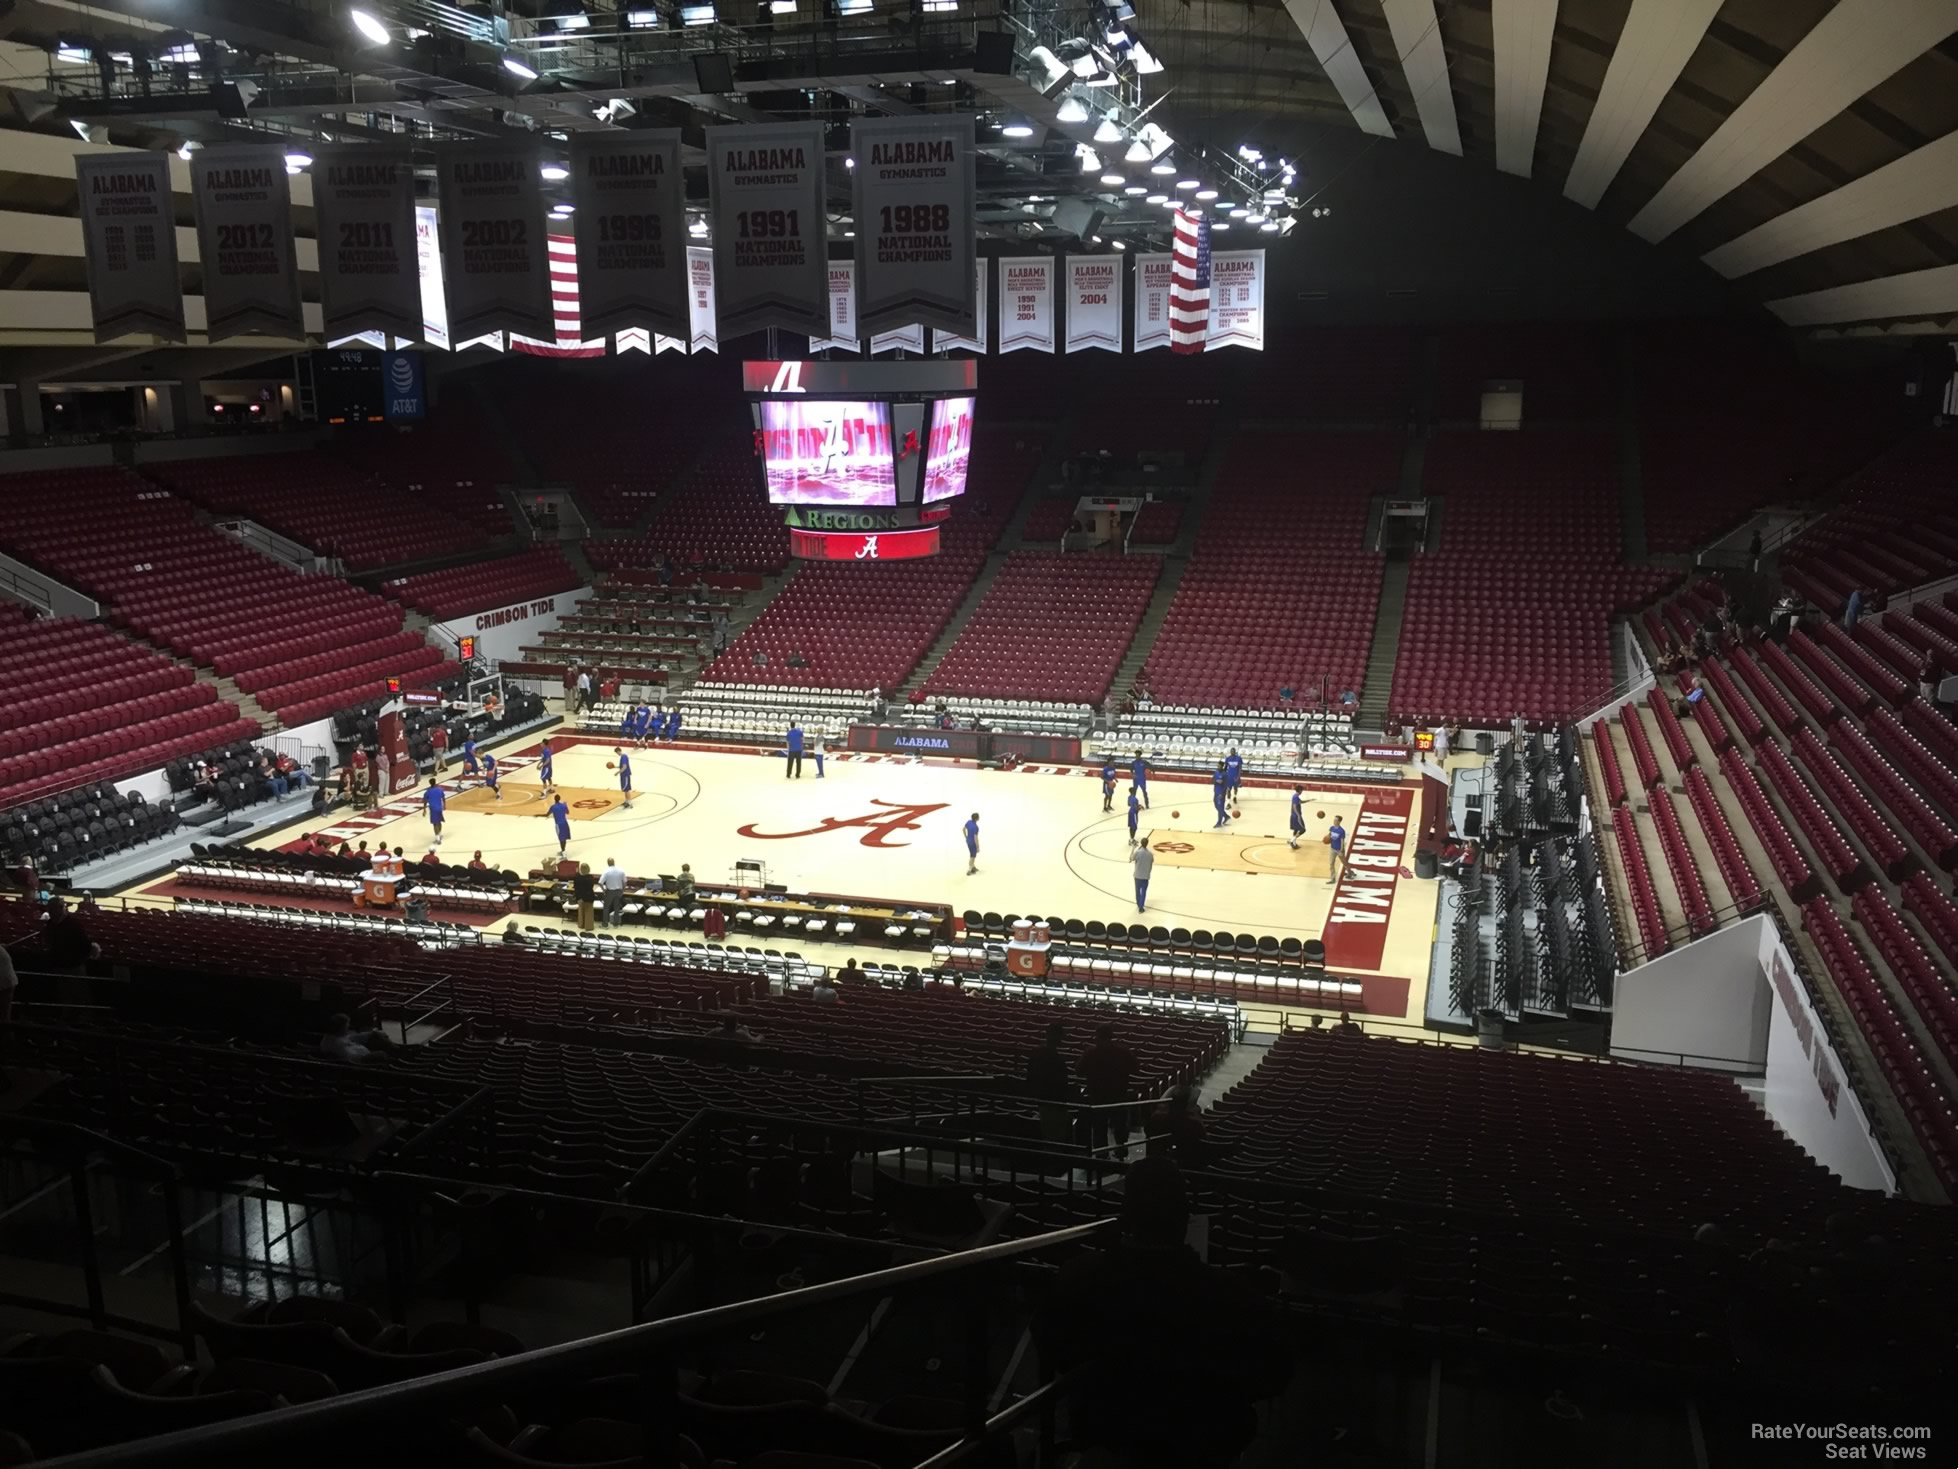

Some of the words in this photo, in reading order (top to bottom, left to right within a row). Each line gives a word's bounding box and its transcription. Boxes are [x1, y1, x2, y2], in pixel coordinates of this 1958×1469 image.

[726, 147, 805, 172] ALABAMA
[871, 141, 954, 165] ALABAMA
[454, 161, 527, 183] ALABAMA
[588, 154, 664, 176] ALABAMA
[207, 168, 273, 190] ALABAMA
[328, 165, 397, 185] ALABAMA
[735, 173, 798, 185] GYMNASTICS
[880, 167, 946, 179] GYMNASTICS
[93, 174, 157, 194] ALABAMA
[736, 209, 800, 238] 1991
[880, 204, 950, 233] 1988
[462, 219, 528, 246] 2002
[598, 214, 661, 241] 1996
[217, 224, 275, 249] 2012
[339, 222, 394, 248] 2011
[735, 240, 805, 254] NATIONAL
[878, 235, 952, 250] NATIONAL
[217, 251, 279, 264] NATIONAL
[337, 249, 399, 263] NATIONAL
[464, 247, 529, 261] NATIONAL
[597, 244, 665, 257] NATIONAL
[878, 249, 952, 263] CHAMPIONS
[598, 257, 665, 270] CHAMPIONS
[736, 254, 805, 267] CHAMPIONS
[1214, 261, 1255, 273] ALABAMA
[219, 263, 280, 275] CHAMPIONS
[338, 263, 400, 274] CHAMPIONS
[464, 262, 530, 274] CHAMPIONS
[829, 270, 850, 280] BAMA
[1008, 267, 1045, 278] ALABAMA
[1075, 265, 1113, 277] ALABAMA
[1145, 263, 1172, 275] ALABA
[1017, 295, 1036, 303] 1990
[1080, 294, 1107, 304] 2004
[1016, 312, 1036, 320] 2004
[392, 399, 417, 414] AT&T
[476, 604, 528, 631] CRIMSON
[530, 598, 555, 617] TIDE
[894, 736, 950, 749] ALABAMA
[1419, 740, 1430, 749] 30
[1330, 811, 1407, 924] ALABAMA
[373, 884, 385, 898] G
[1019, 954, 1033, 969] G
